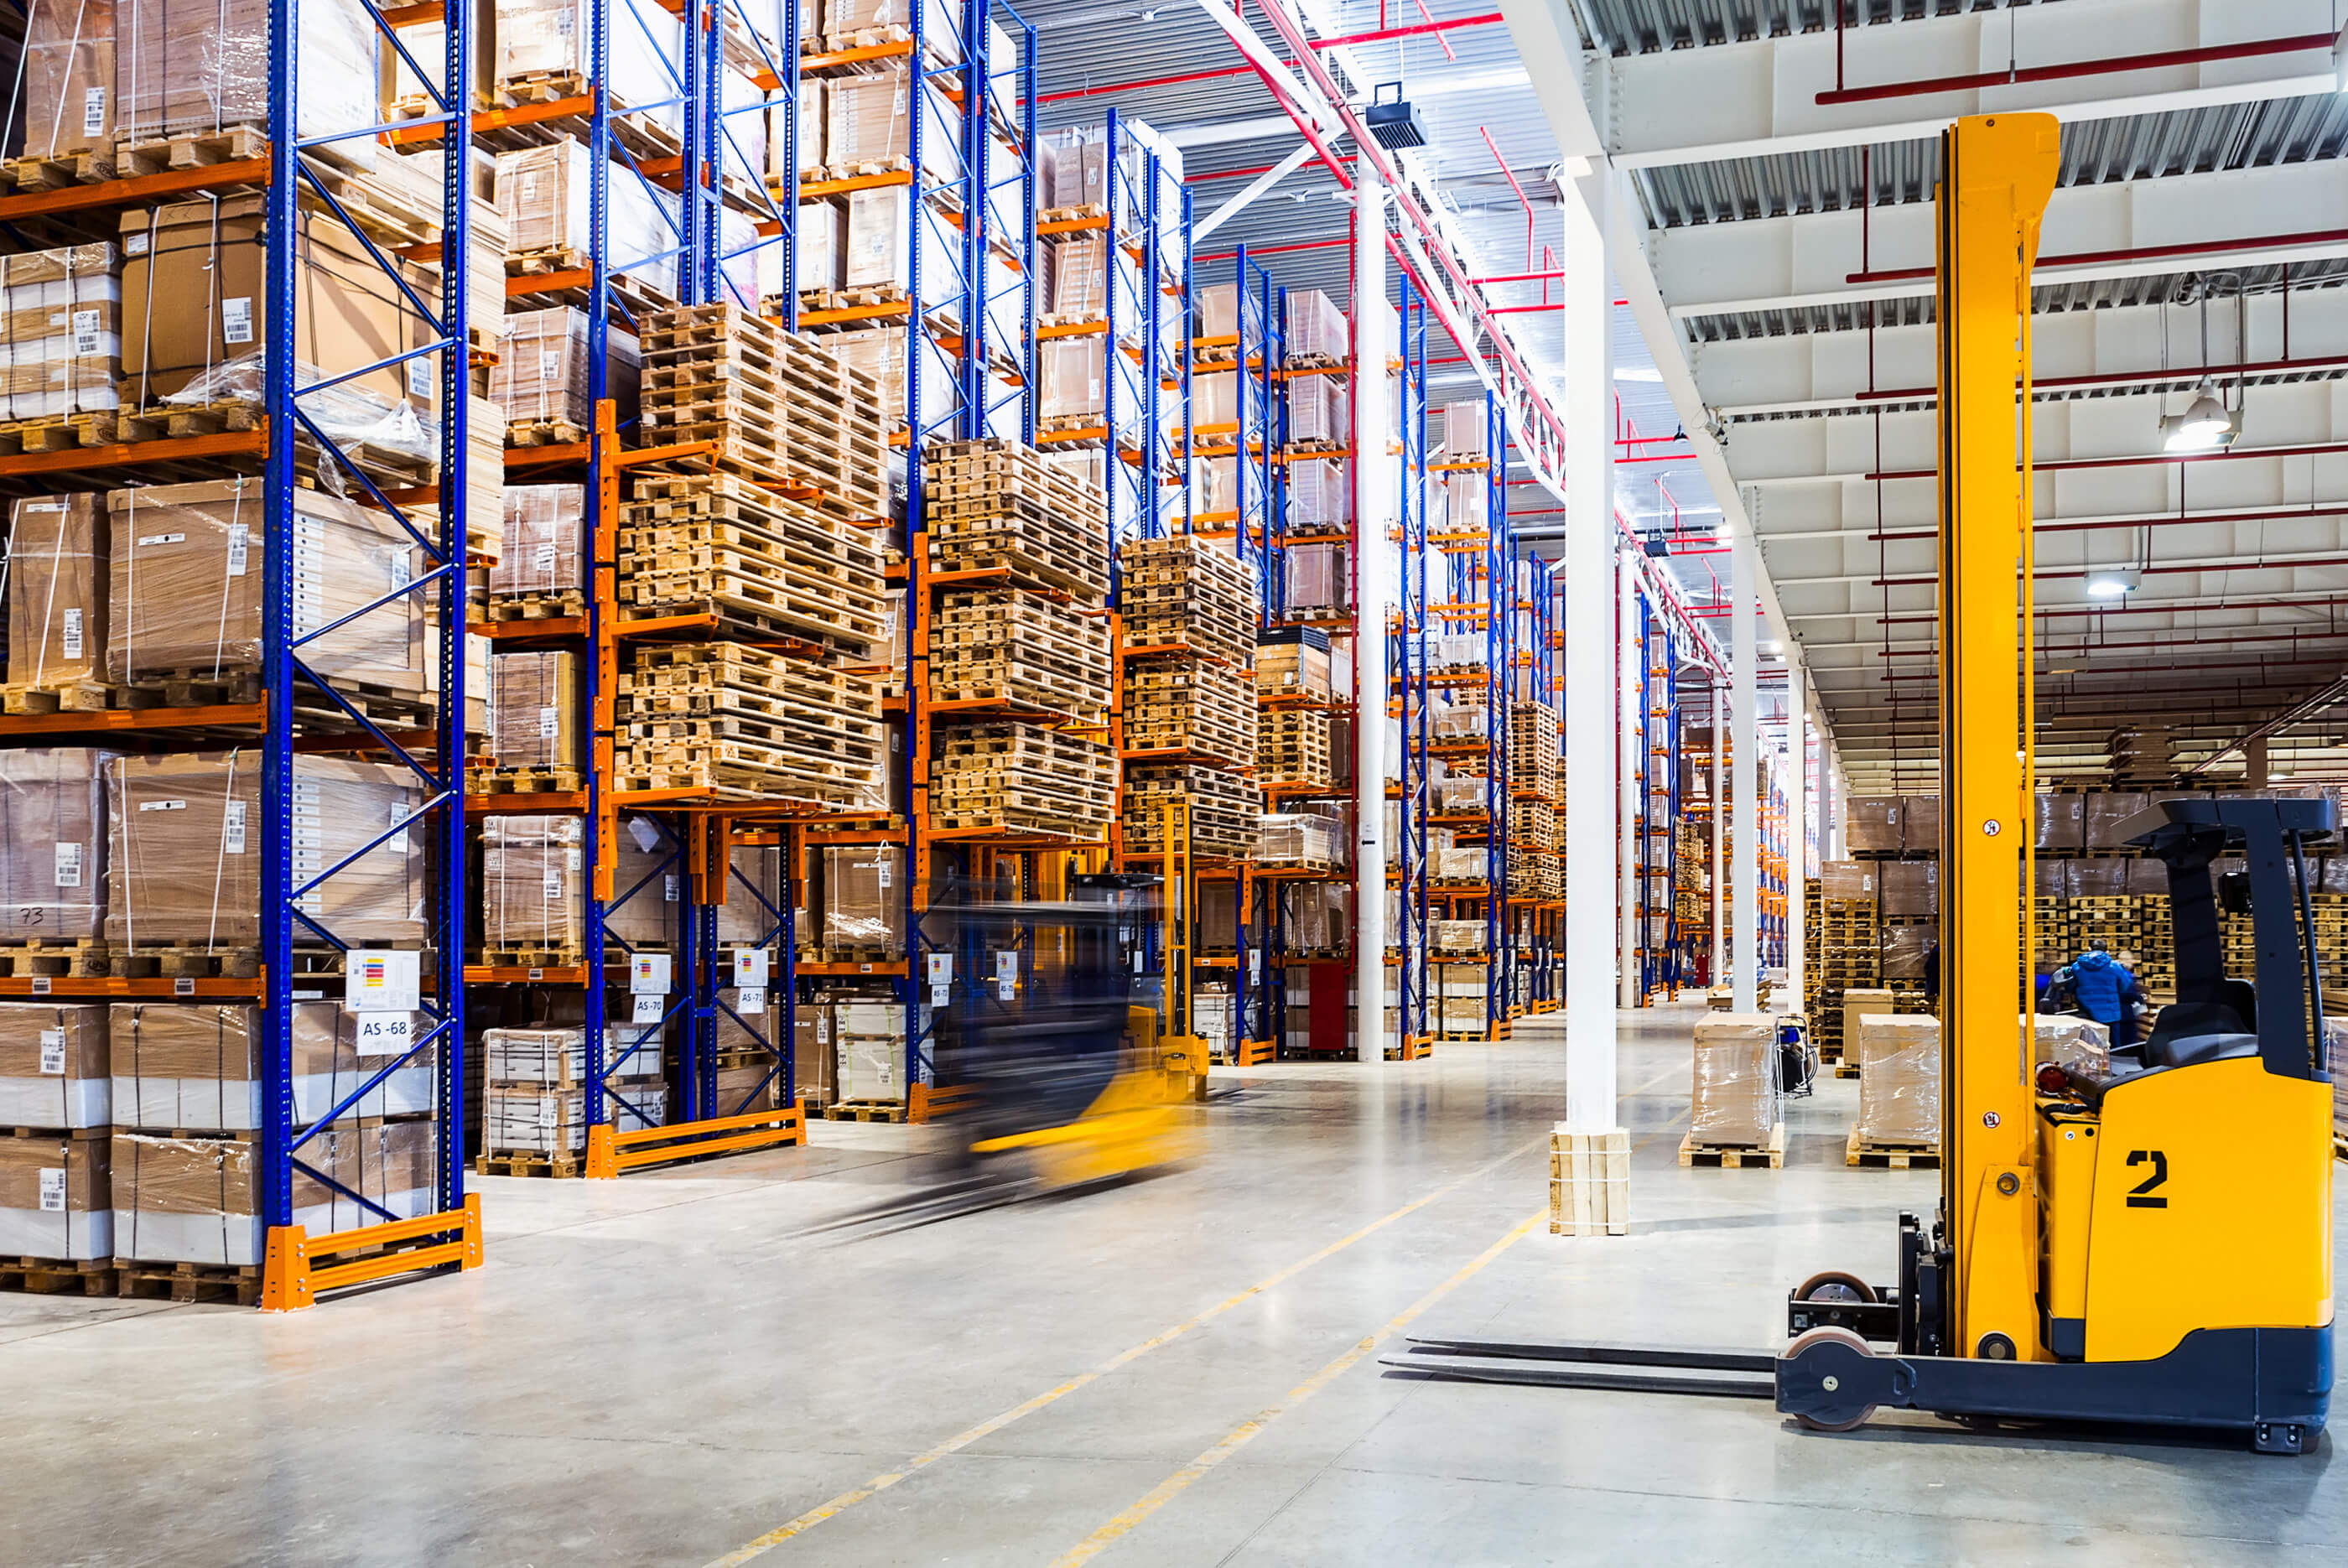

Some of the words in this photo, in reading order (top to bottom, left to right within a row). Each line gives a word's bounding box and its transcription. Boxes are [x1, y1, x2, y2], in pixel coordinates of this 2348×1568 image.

[20, 907, 44, 925] 73
[741, 993, 752, 1002] AS
[637, 1001, 648, 1010] AS
[650, 1001, 662, 1010] -70
[363, 1022, 382, 1036] AS
[386, 1021, 407, 1035] -68
[2127, 1150, 2168, 1208] 2
